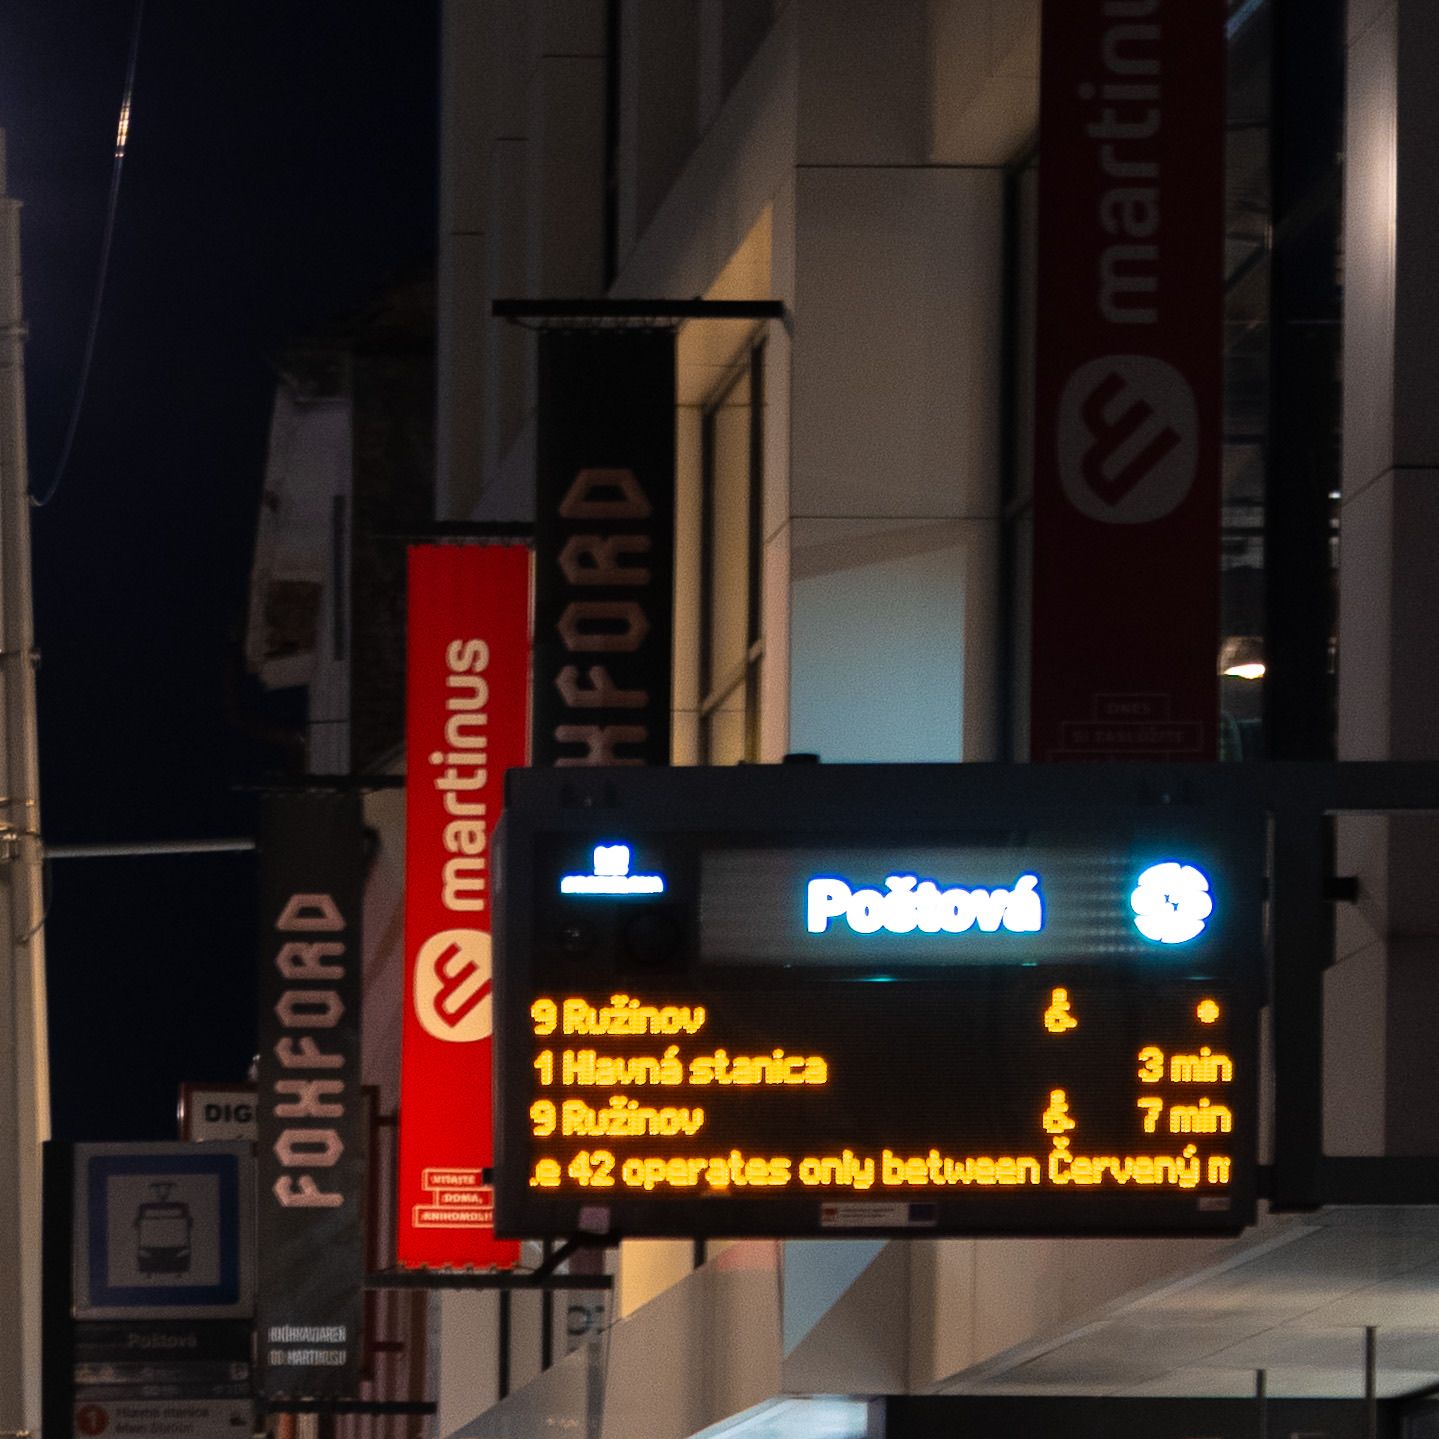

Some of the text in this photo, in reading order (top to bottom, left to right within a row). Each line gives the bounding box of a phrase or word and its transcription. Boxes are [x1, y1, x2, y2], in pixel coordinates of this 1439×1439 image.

[430, 639, 489, 917] martinus
[807, 873, 1043, 934] Poštová
[530, 994, 706, 1035] 9 Ružinov
[533, 1045, 1233, 1087] 1 Hlavná stanica 3 min
[530, 1095, 1232, 1136] 9 Ružinov 7 min
[568, 1150, 616, 1187] 42
[622, 1149, 792, 1191] operates
[799, 1149, 876, 1190] only
[882, 1148, 1041, 1187] between
[1048, 1136, 1201, 1189] Červený
